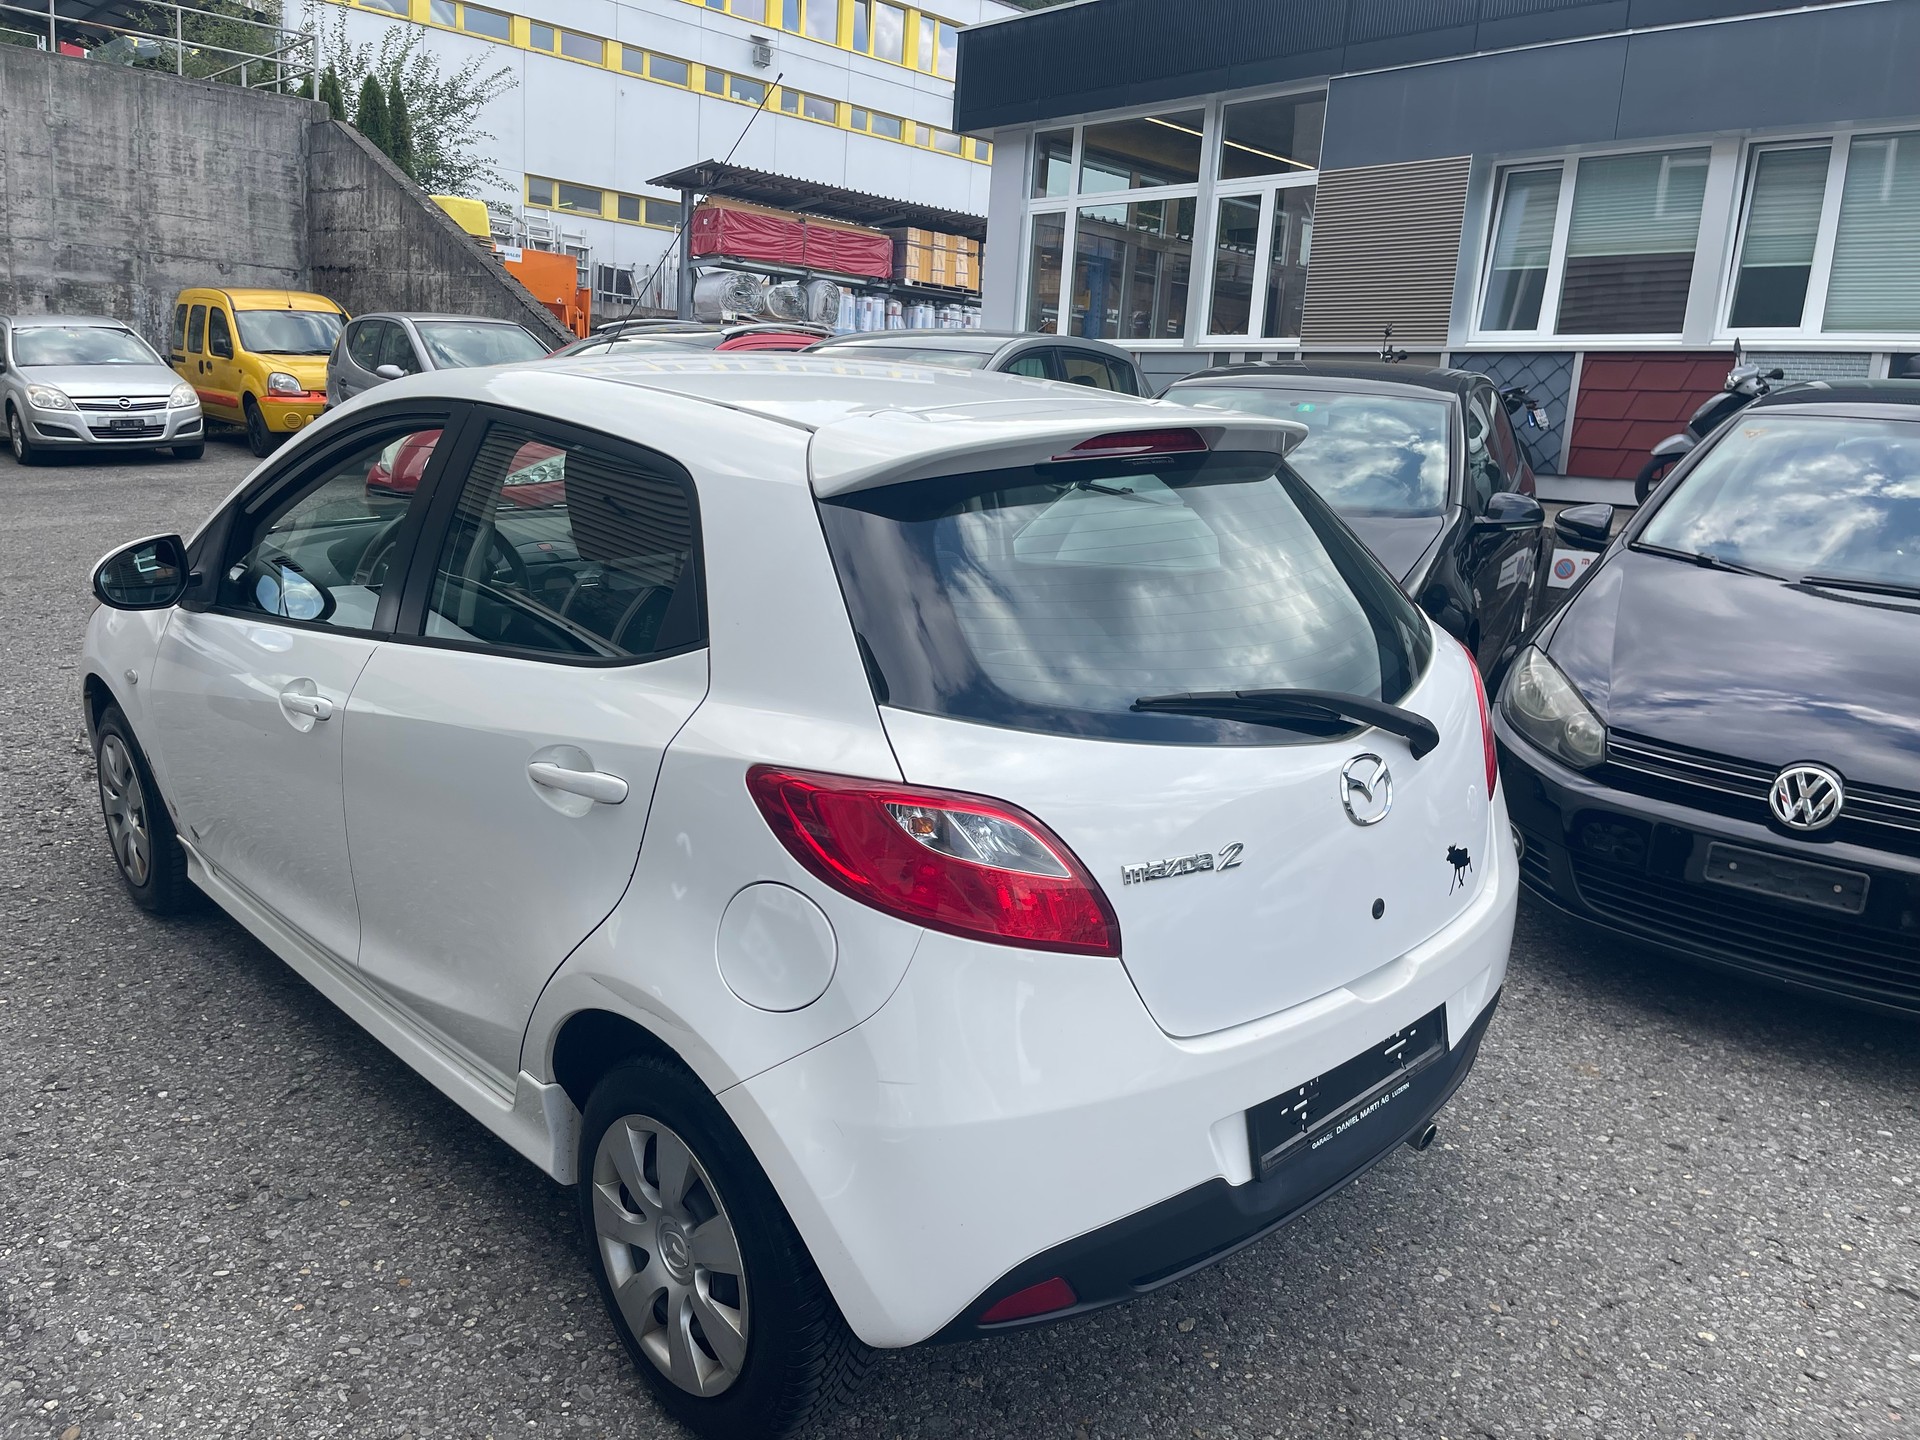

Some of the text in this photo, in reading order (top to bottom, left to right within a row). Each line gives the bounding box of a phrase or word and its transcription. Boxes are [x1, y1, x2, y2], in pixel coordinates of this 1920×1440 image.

[1216, 841, 1244, 872] 2
[1311, 1082, 1410, 1149] GARAGE DANIEL MARTI AG LUZERN
